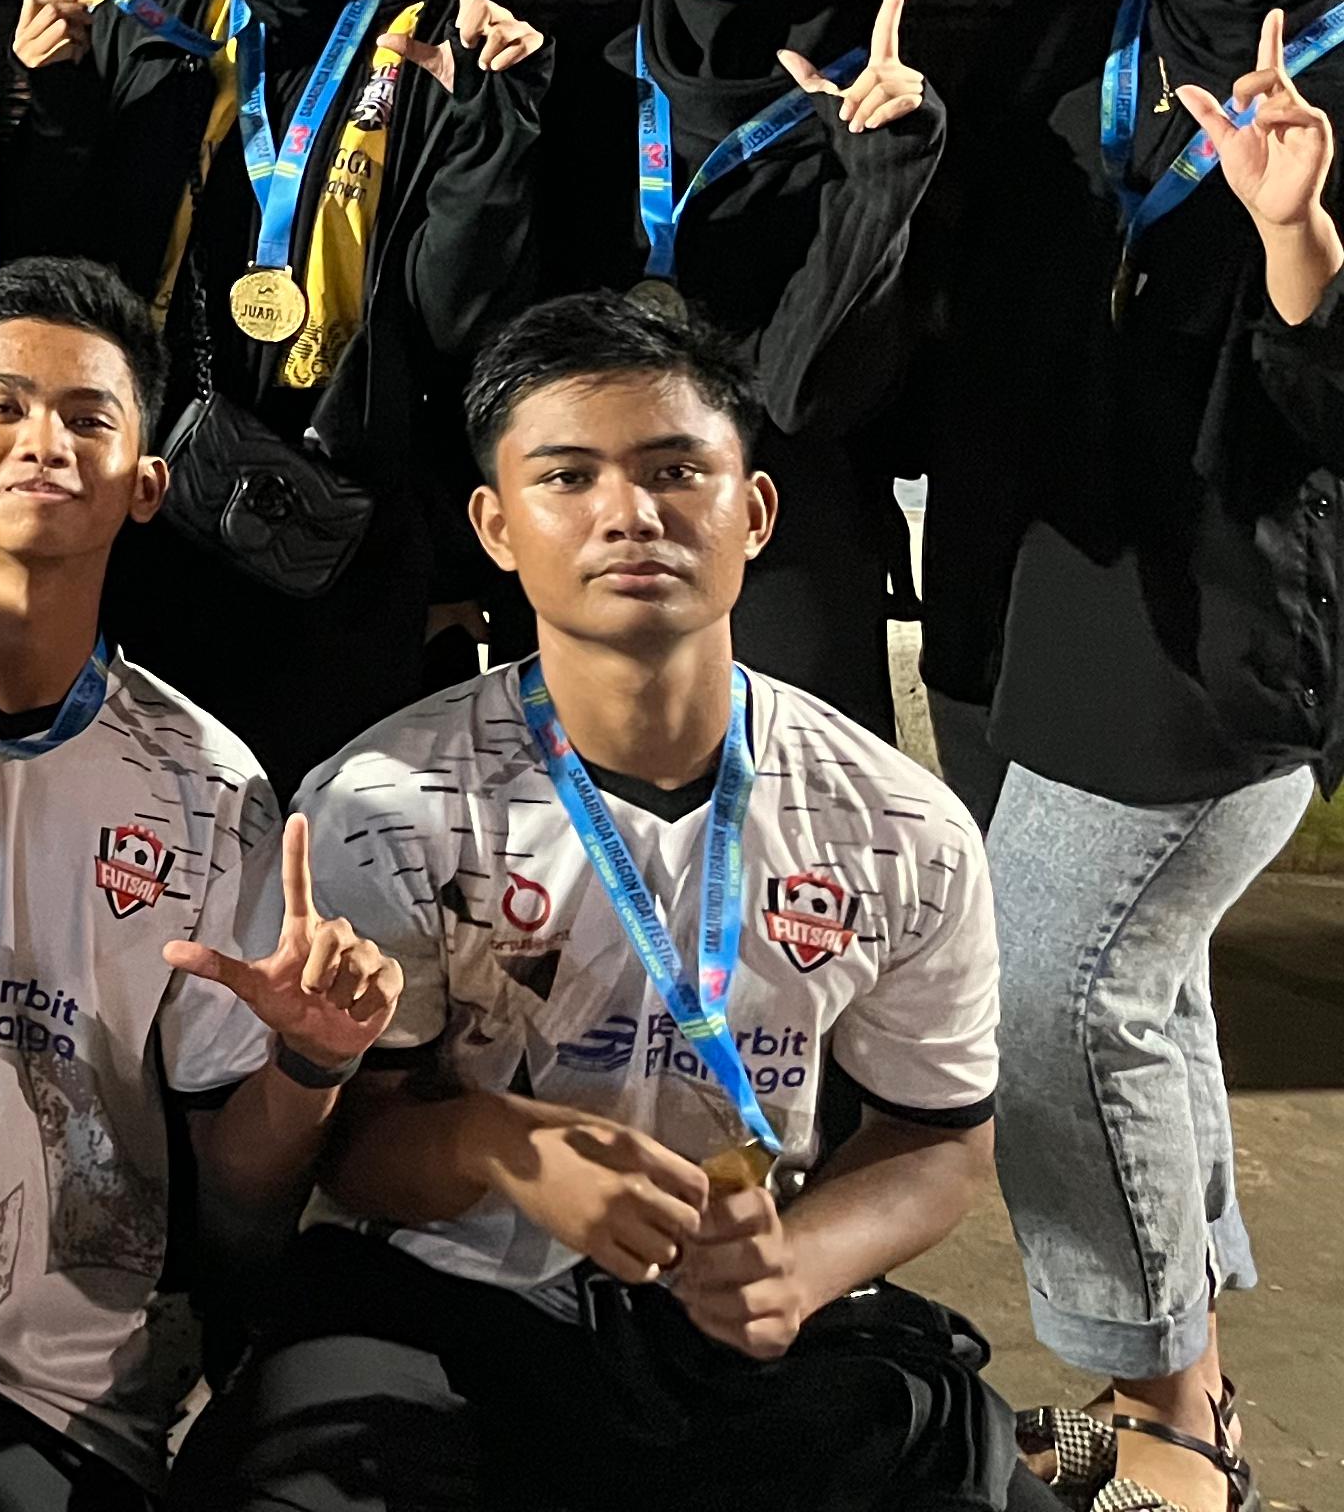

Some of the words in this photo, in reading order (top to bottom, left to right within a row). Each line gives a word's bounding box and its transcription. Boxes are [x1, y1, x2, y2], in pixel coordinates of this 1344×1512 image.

[241, 304, 282, 321] JUARA
[567, 765, 614, 842] SAMARINDA
[602, 837, 641, 894] DRAGON
[628, 888, 658, 927] BOAT
[100, 865, 162, 901] FUTSAL
[771, 912, 847, 953] FUTSAL
